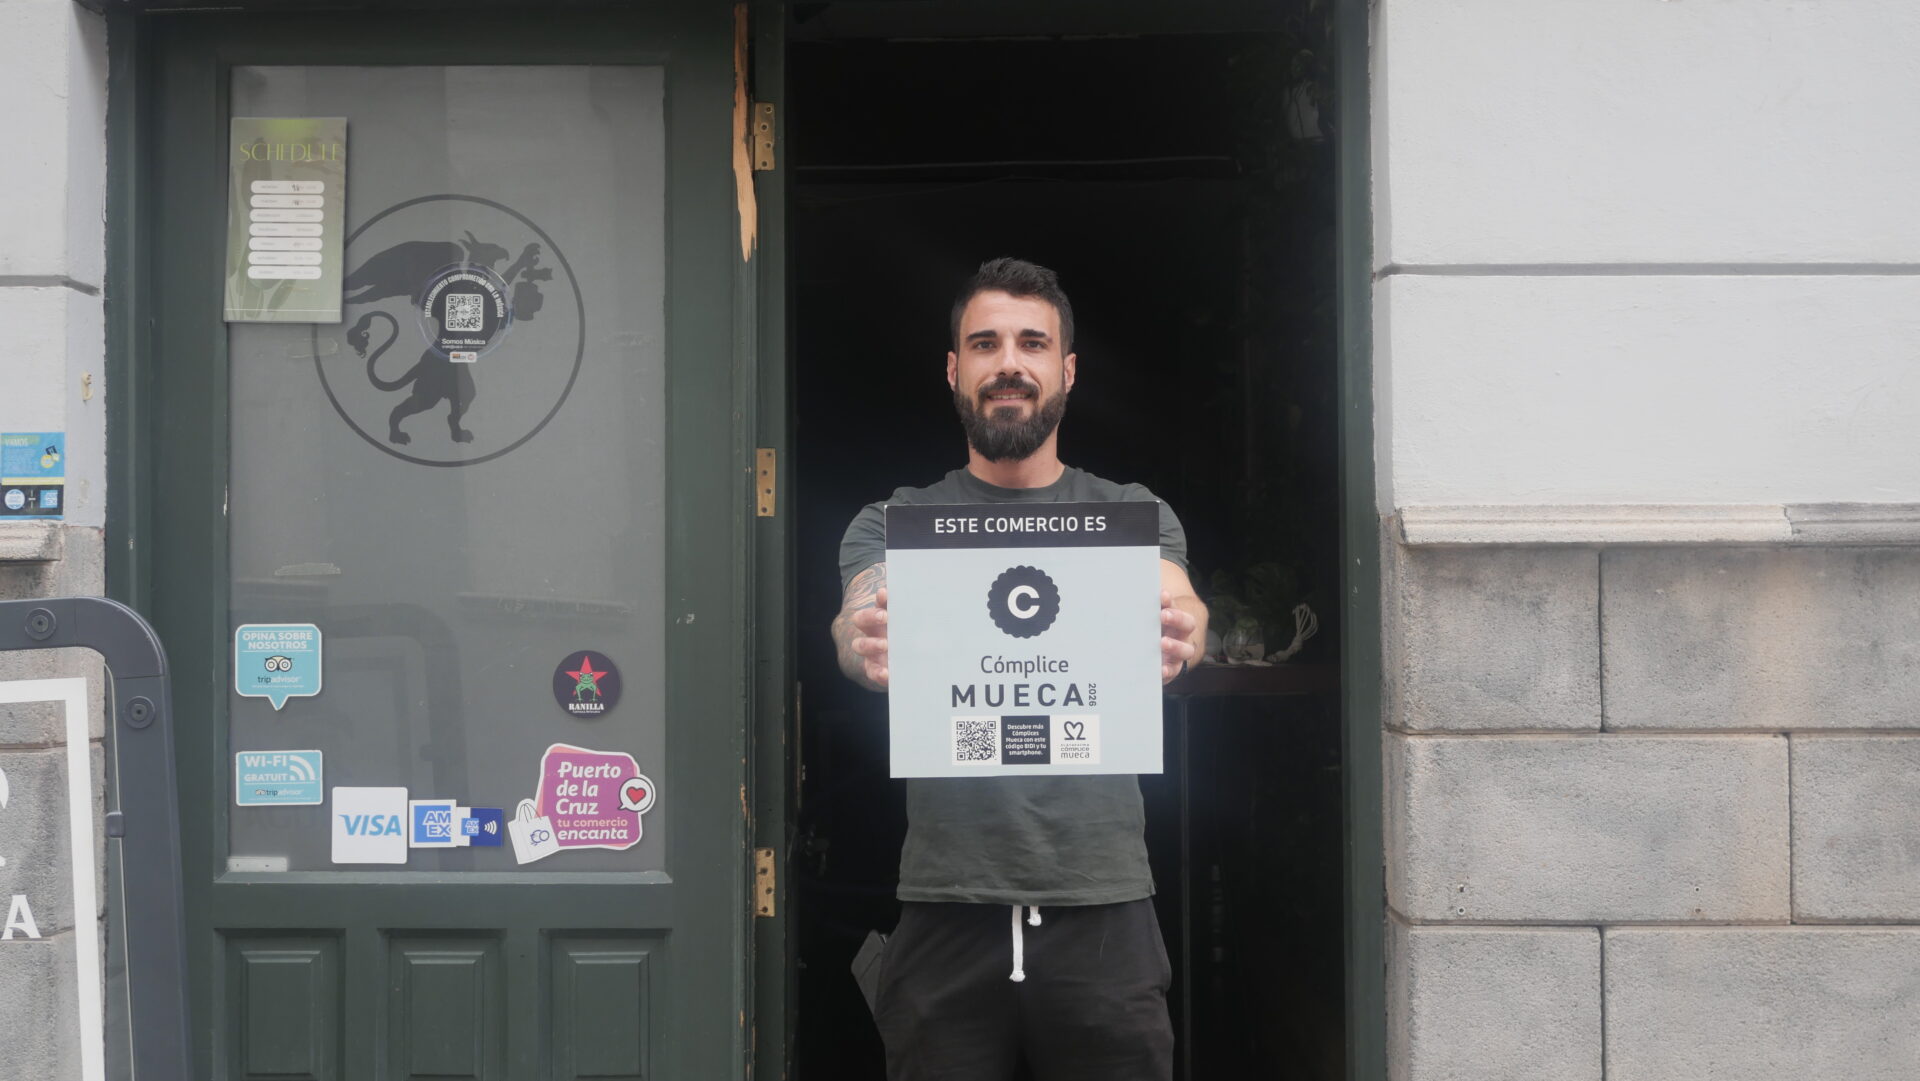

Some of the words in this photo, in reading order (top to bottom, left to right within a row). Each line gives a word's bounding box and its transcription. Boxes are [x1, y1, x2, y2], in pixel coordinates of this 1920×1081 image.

[934, 518, 978, 534] ESTE
[984, 516, 1079, 533] COMERCIO
[1084, 516, 1107, 532] ES
[1007, 585, 1041, 619] C
[242, 632, 276, 641] OPINA
[278, 632, 313, 640] SOBRE
[248, 640, 307, 650] NOSOTROS
[980, 655, 1069, 679] Cómplice
[951, 683, 1085, 708] MUECA
[1088, 683, 1097, 707] 2026
[569, 703, 604, 711] RANILLA
[244, 755, 287, 767] WI-FI
[557, 761, 622, 778] Puerto
[244, 773, 288, 782] GRATUIT
[556, 780, 579, 797] de
[582, 780, 599, 797] la
[555, 798, 599, 815] Cruz
[338, 814, 402, 836] VISA
[558, 818, 570, 828] tu
[573, 816, 628, 827] comercio
[557, 827, 628, 840] encanta
